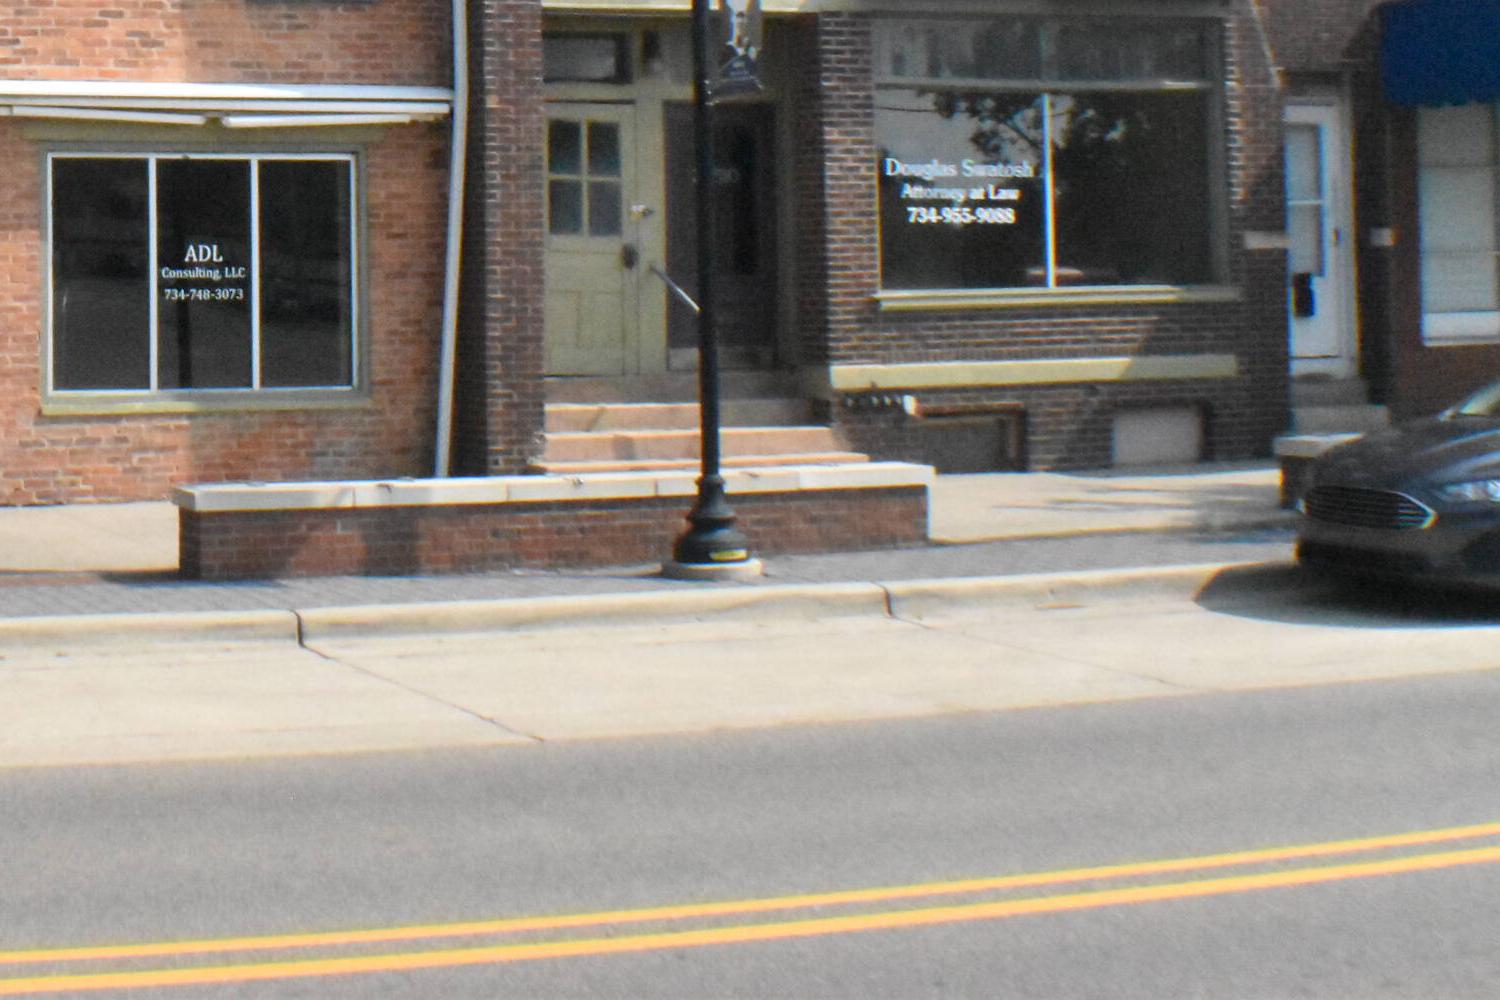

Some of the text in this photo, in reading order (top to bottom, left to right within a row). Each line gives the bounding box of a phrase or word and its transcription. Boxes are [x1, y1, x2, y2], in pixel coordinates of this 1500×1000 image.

[885, 158, 958, 181] Douglas
[900, 182, 1021, 203] Attorney at Law
[184, 244, 223, 263] ADL
[161, 266, 246, 281] Consulting, LLC
[164, 288, 244, 301] 734-748-3073
